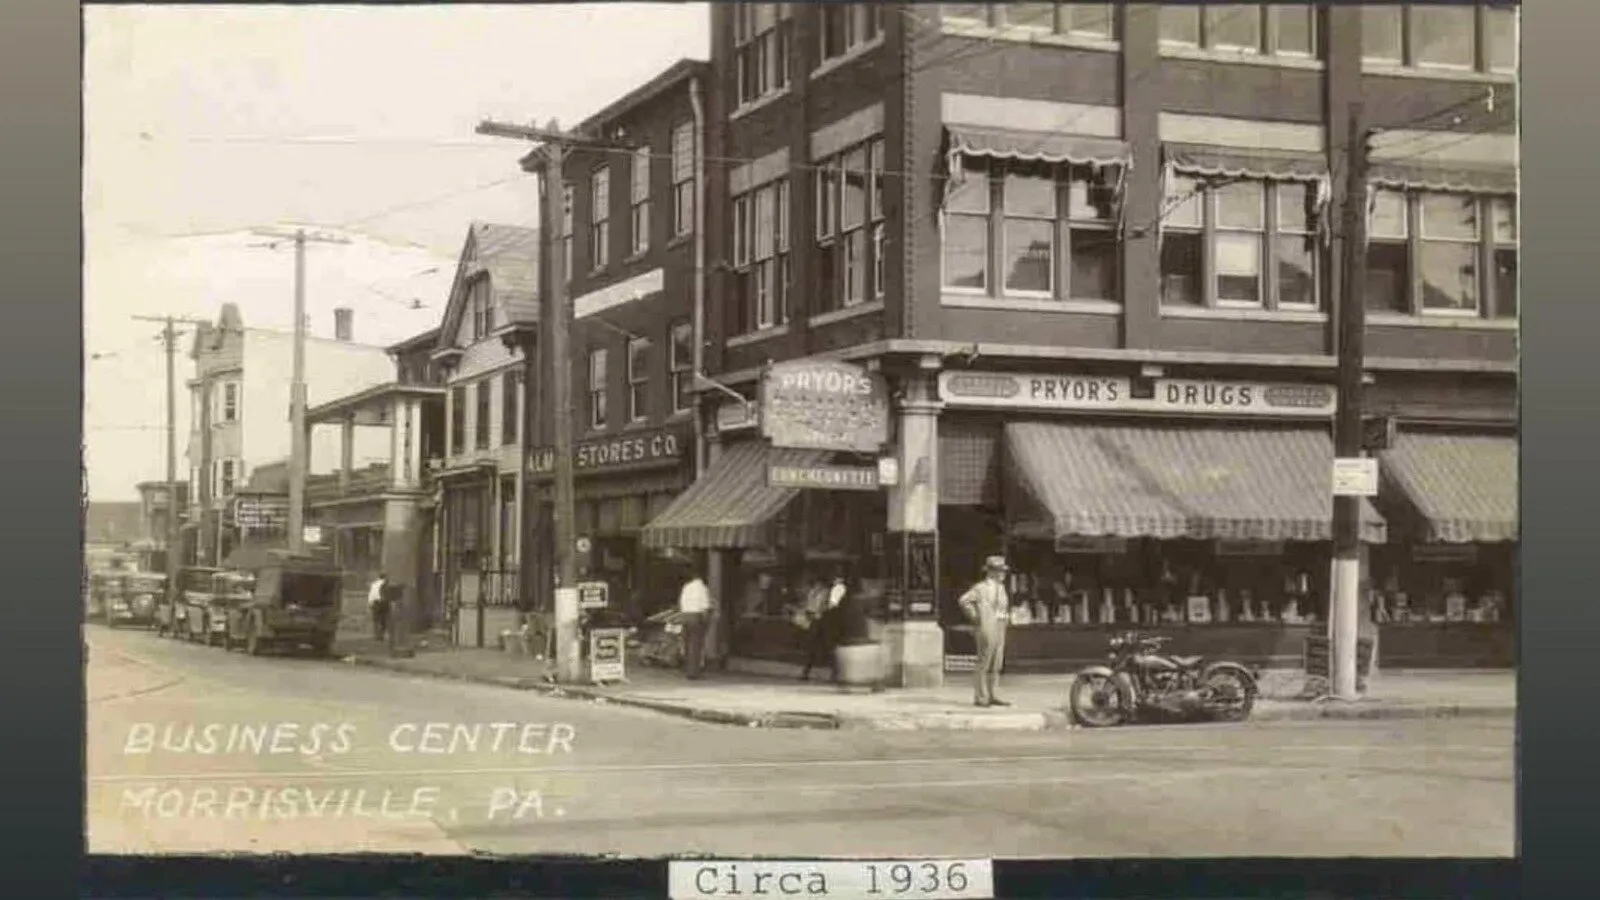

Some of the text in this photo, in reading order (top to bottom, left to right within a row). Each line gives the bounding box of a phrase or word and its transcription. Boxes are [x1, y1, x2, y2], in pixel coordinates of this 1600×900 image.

[1030, 379, 1118, 402] PRYOR'S
[1167, 384, 1253, 407] DRUGS
[577, 439, 645, 466] STORES
